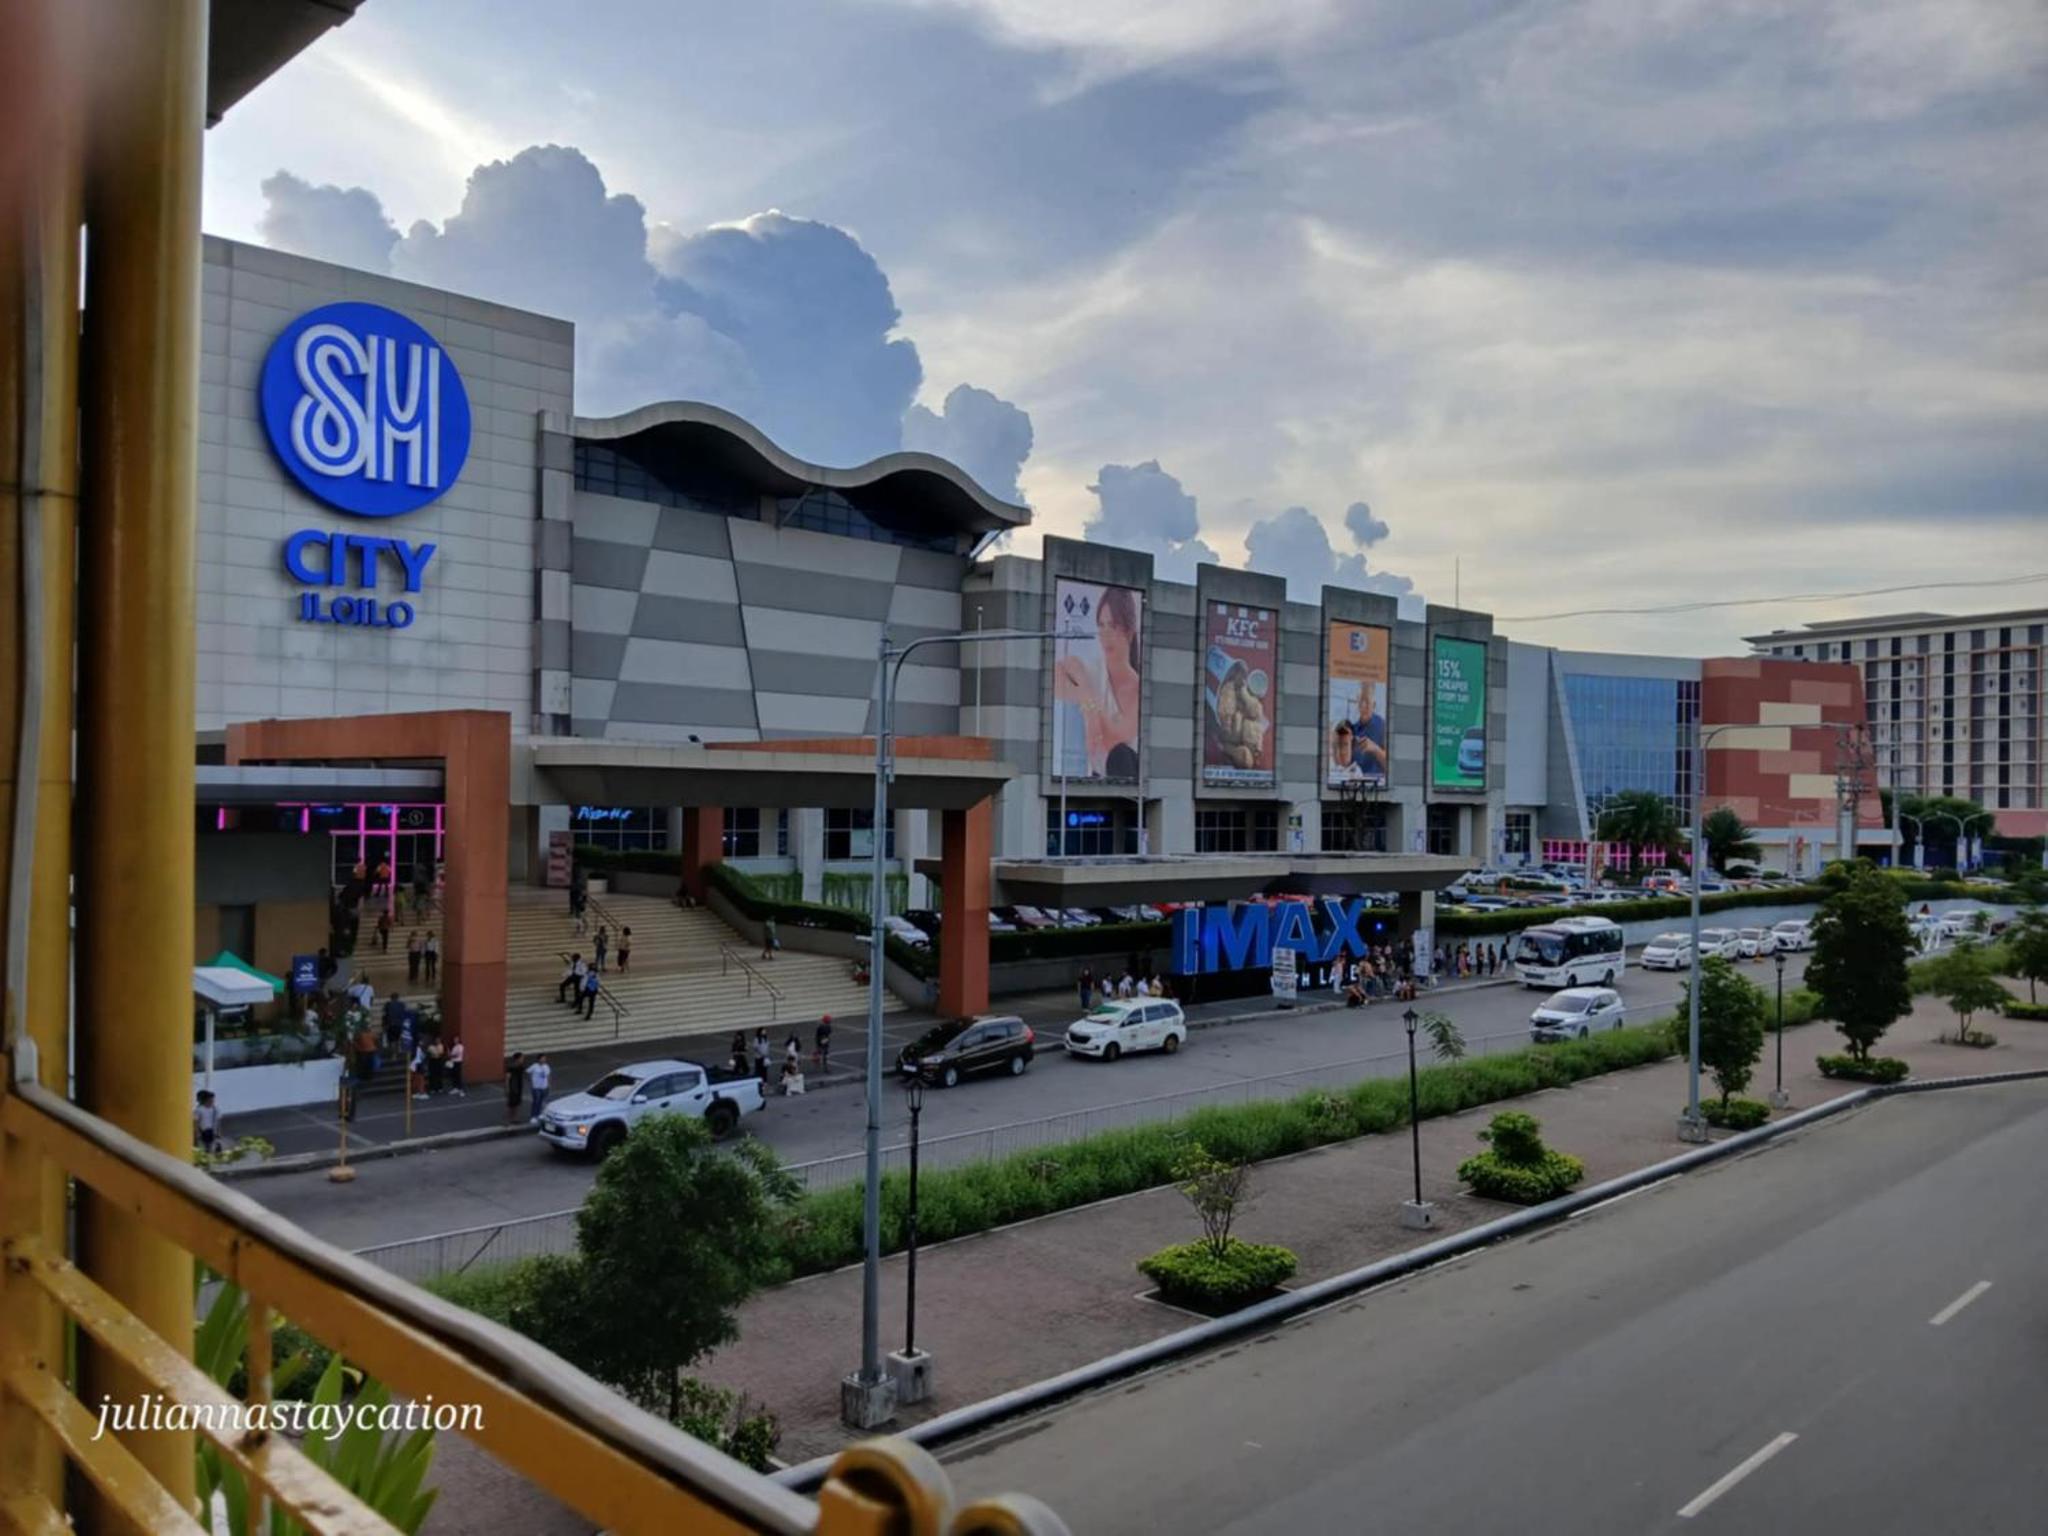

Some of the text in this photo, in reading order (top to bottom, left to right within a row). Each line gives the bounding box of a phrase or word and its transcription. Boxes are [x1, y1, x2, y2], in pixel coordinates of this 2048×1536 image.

[290, 323, 440, 488] SM
[284, 528, 437, 594] CITY
[298, 592, 414, 629] ILOILO
[1226, 617, 1259, 639] KFC
[1438, 659, 1461, 678] 15%
[1172, 897, 1369, 976] IMAX
